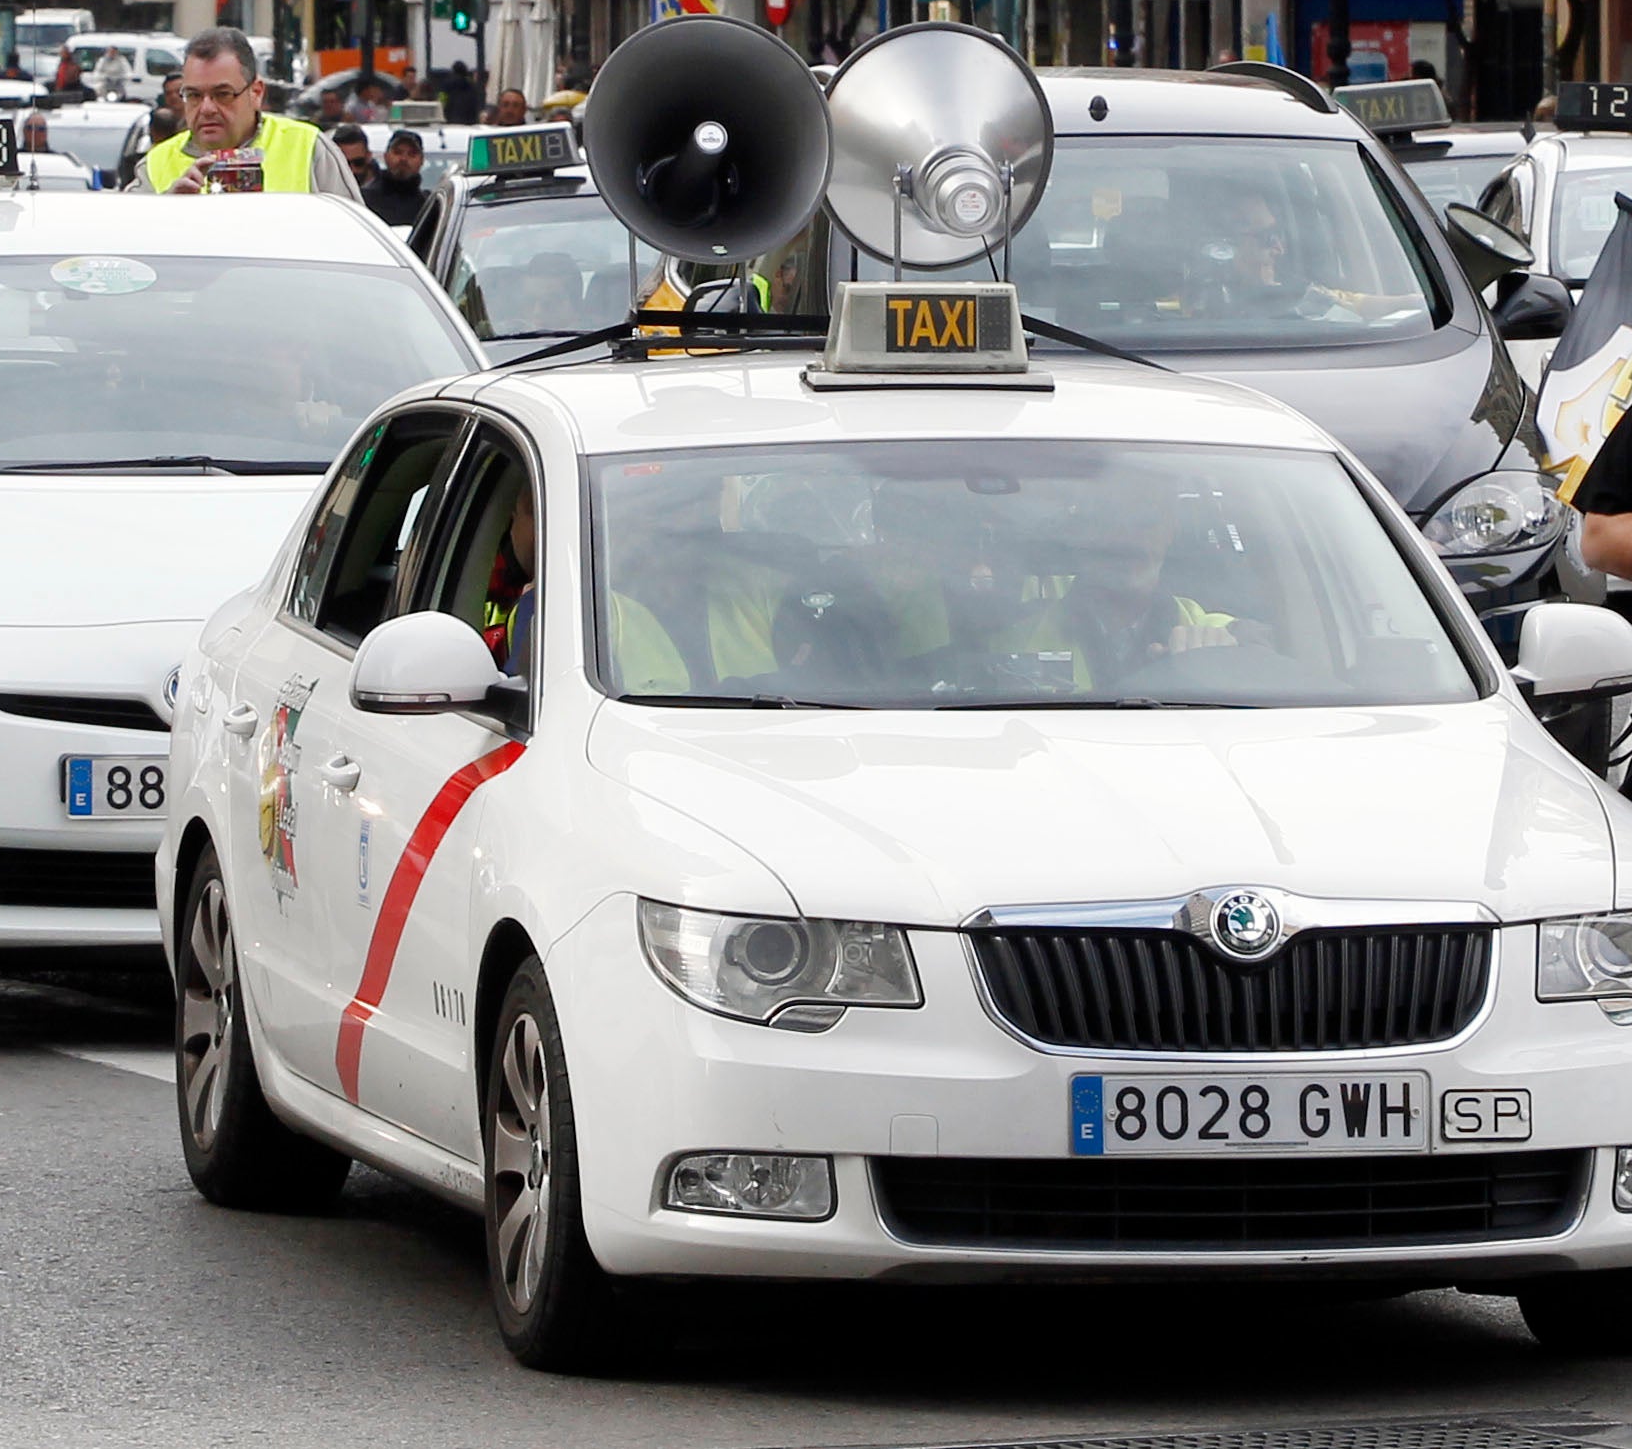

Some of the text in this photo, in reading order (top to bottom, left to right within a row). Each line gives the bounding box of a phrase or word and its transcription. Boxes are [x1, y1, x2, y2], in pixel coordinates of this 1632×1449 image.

[1356, 95, 1405, 121] TAXI
[492, 133, 542, 165] TAXI
[889, 300, 976, 349] TAXI
[76, 765, 166, 810] E 88
[1081, 1081, 1417, 1143] E 8028 GWH
[1453, 1095, 1523, 1134] SP
